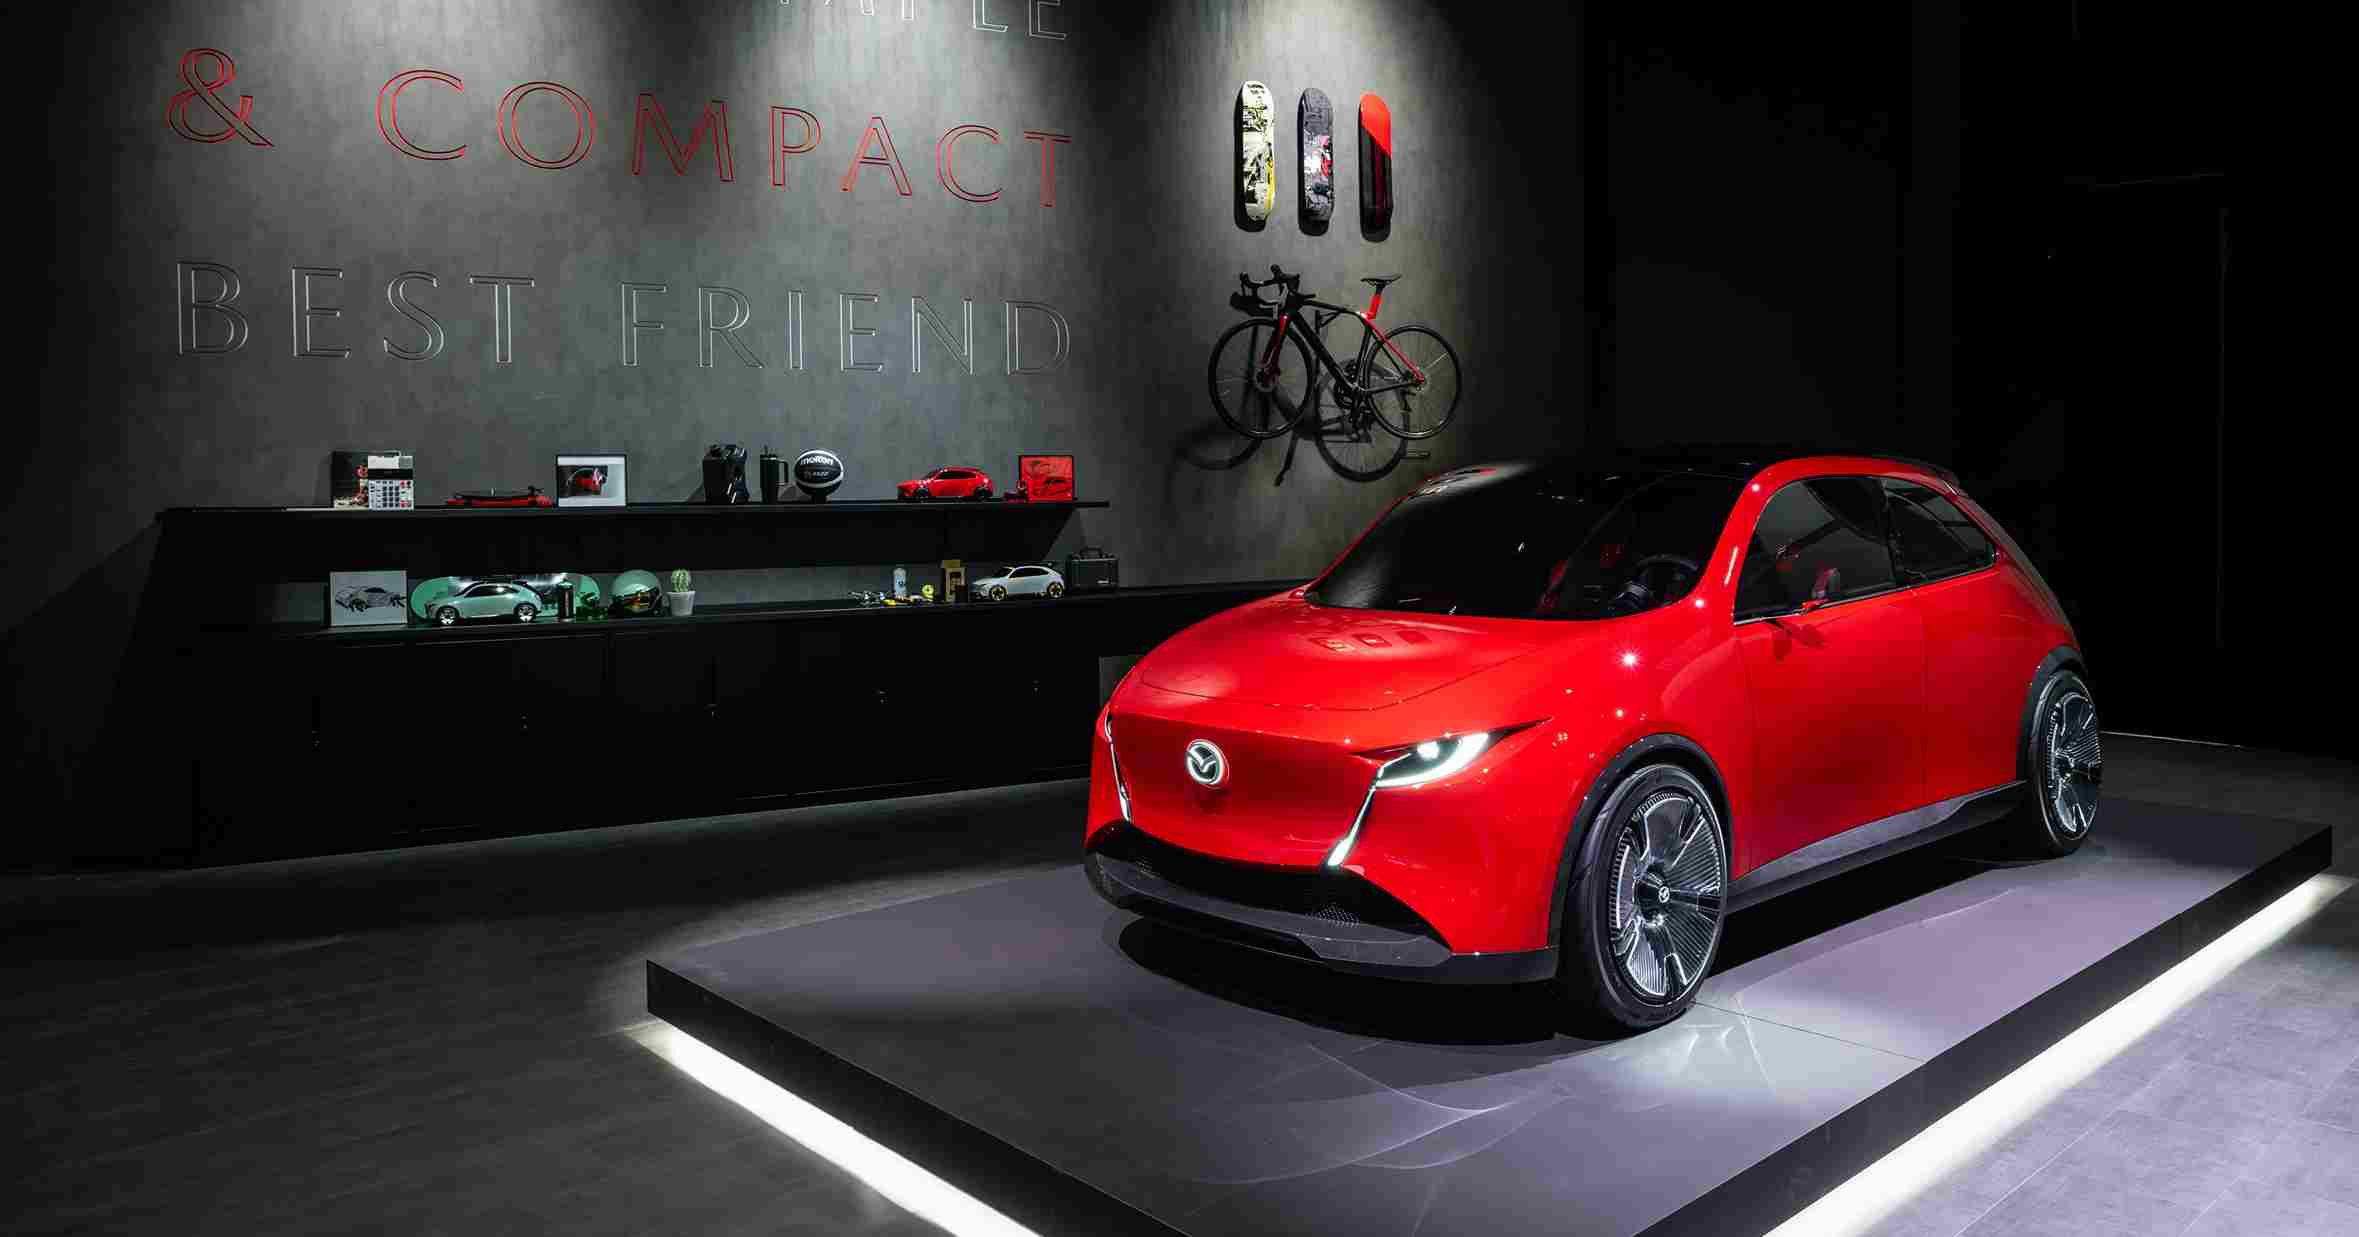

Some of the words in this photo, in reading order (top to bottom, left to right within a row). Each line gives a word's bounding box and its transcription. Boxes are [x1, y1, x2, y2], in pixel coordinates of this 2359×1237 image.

[166, 47, 275, 148] &
[375, 68, 1073, 208] COMPACT
[176, 260, 536, 364] BEST
[620, 280, 1071, 376] FRIEND
